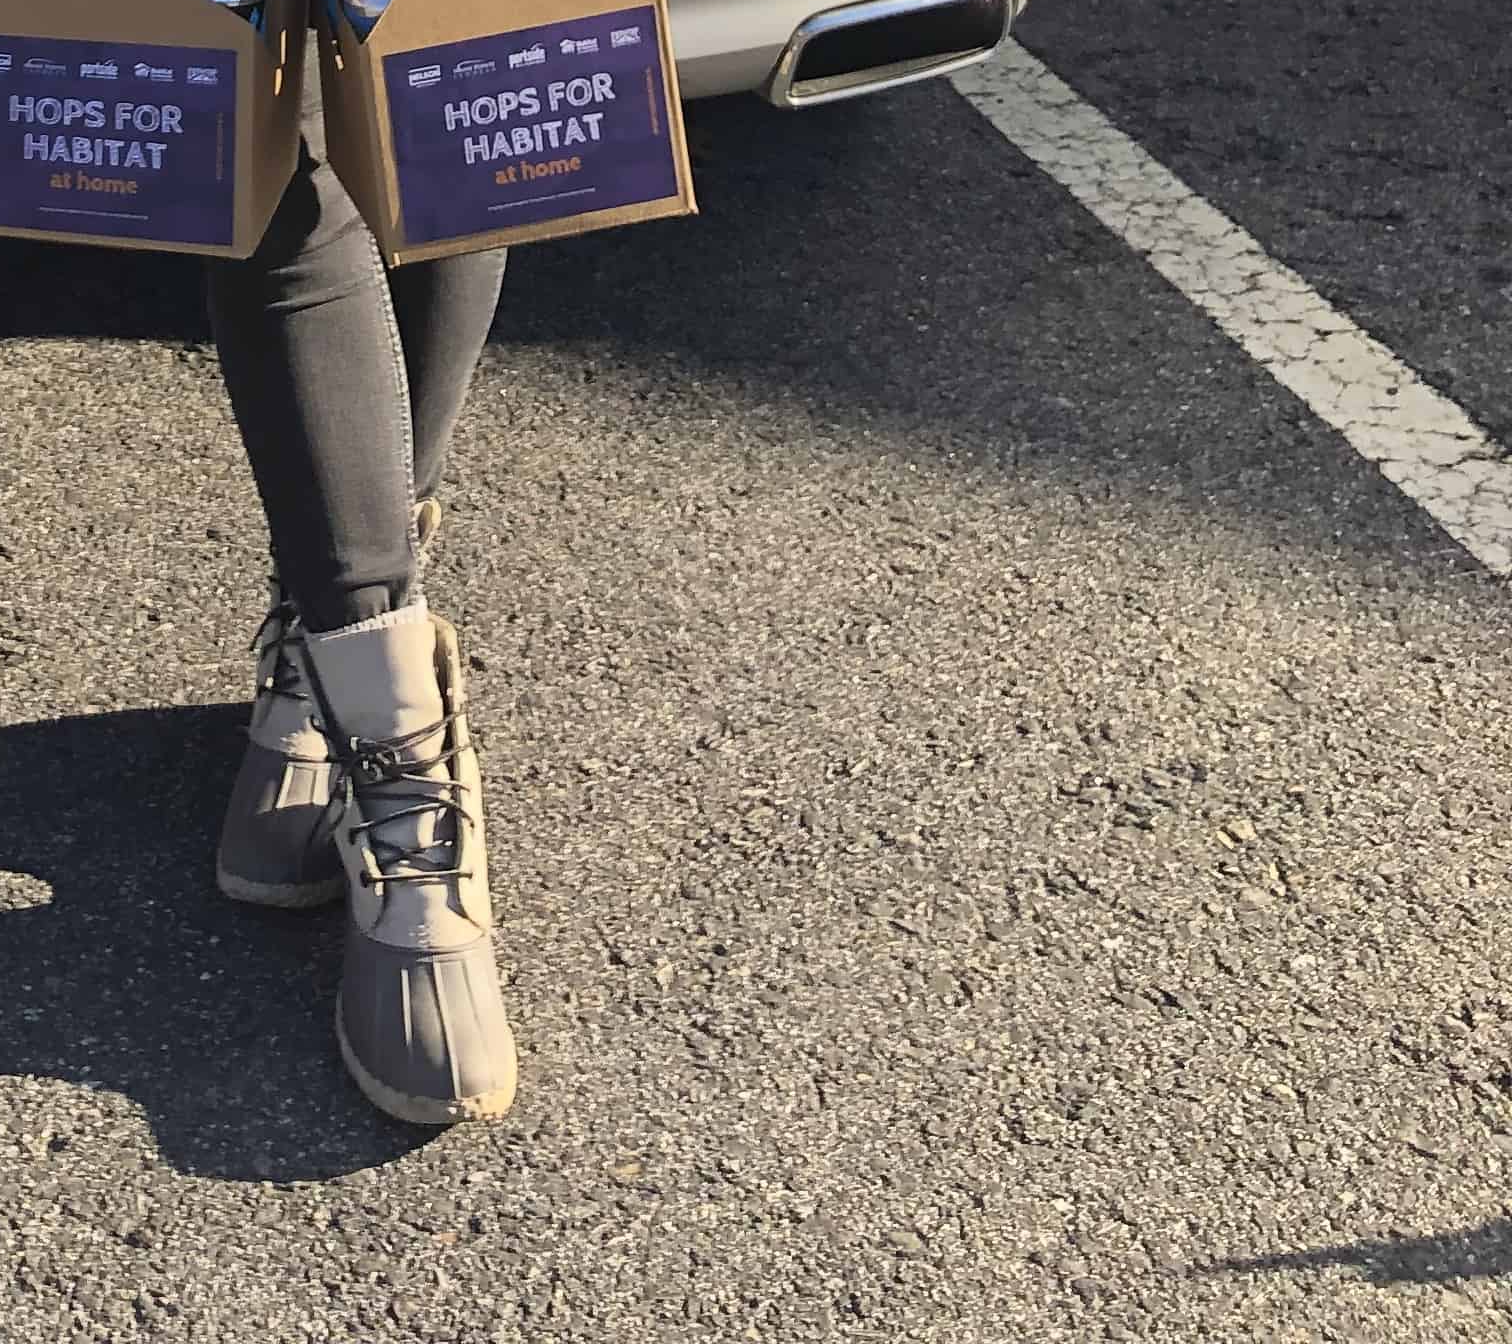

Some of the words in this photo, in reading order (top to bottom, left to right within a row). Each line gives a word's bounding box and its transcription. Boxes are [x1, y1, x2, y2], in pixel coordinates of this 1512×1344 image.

[8, 95, 106, 128] HOPS
[114, 102, 184, 133] FOR
[444, 87, 541, 131] HOPS
[546, 73, 616, 112] FOR
[23, 133, 168, 169] HABITAT
[463, 112, 604, 164] HABITAT
[49, 172, 72, 190] at
[77, 170, 139, 194] home
[495, 165, 517, 185] at
[520, 156, 582, 180] home
